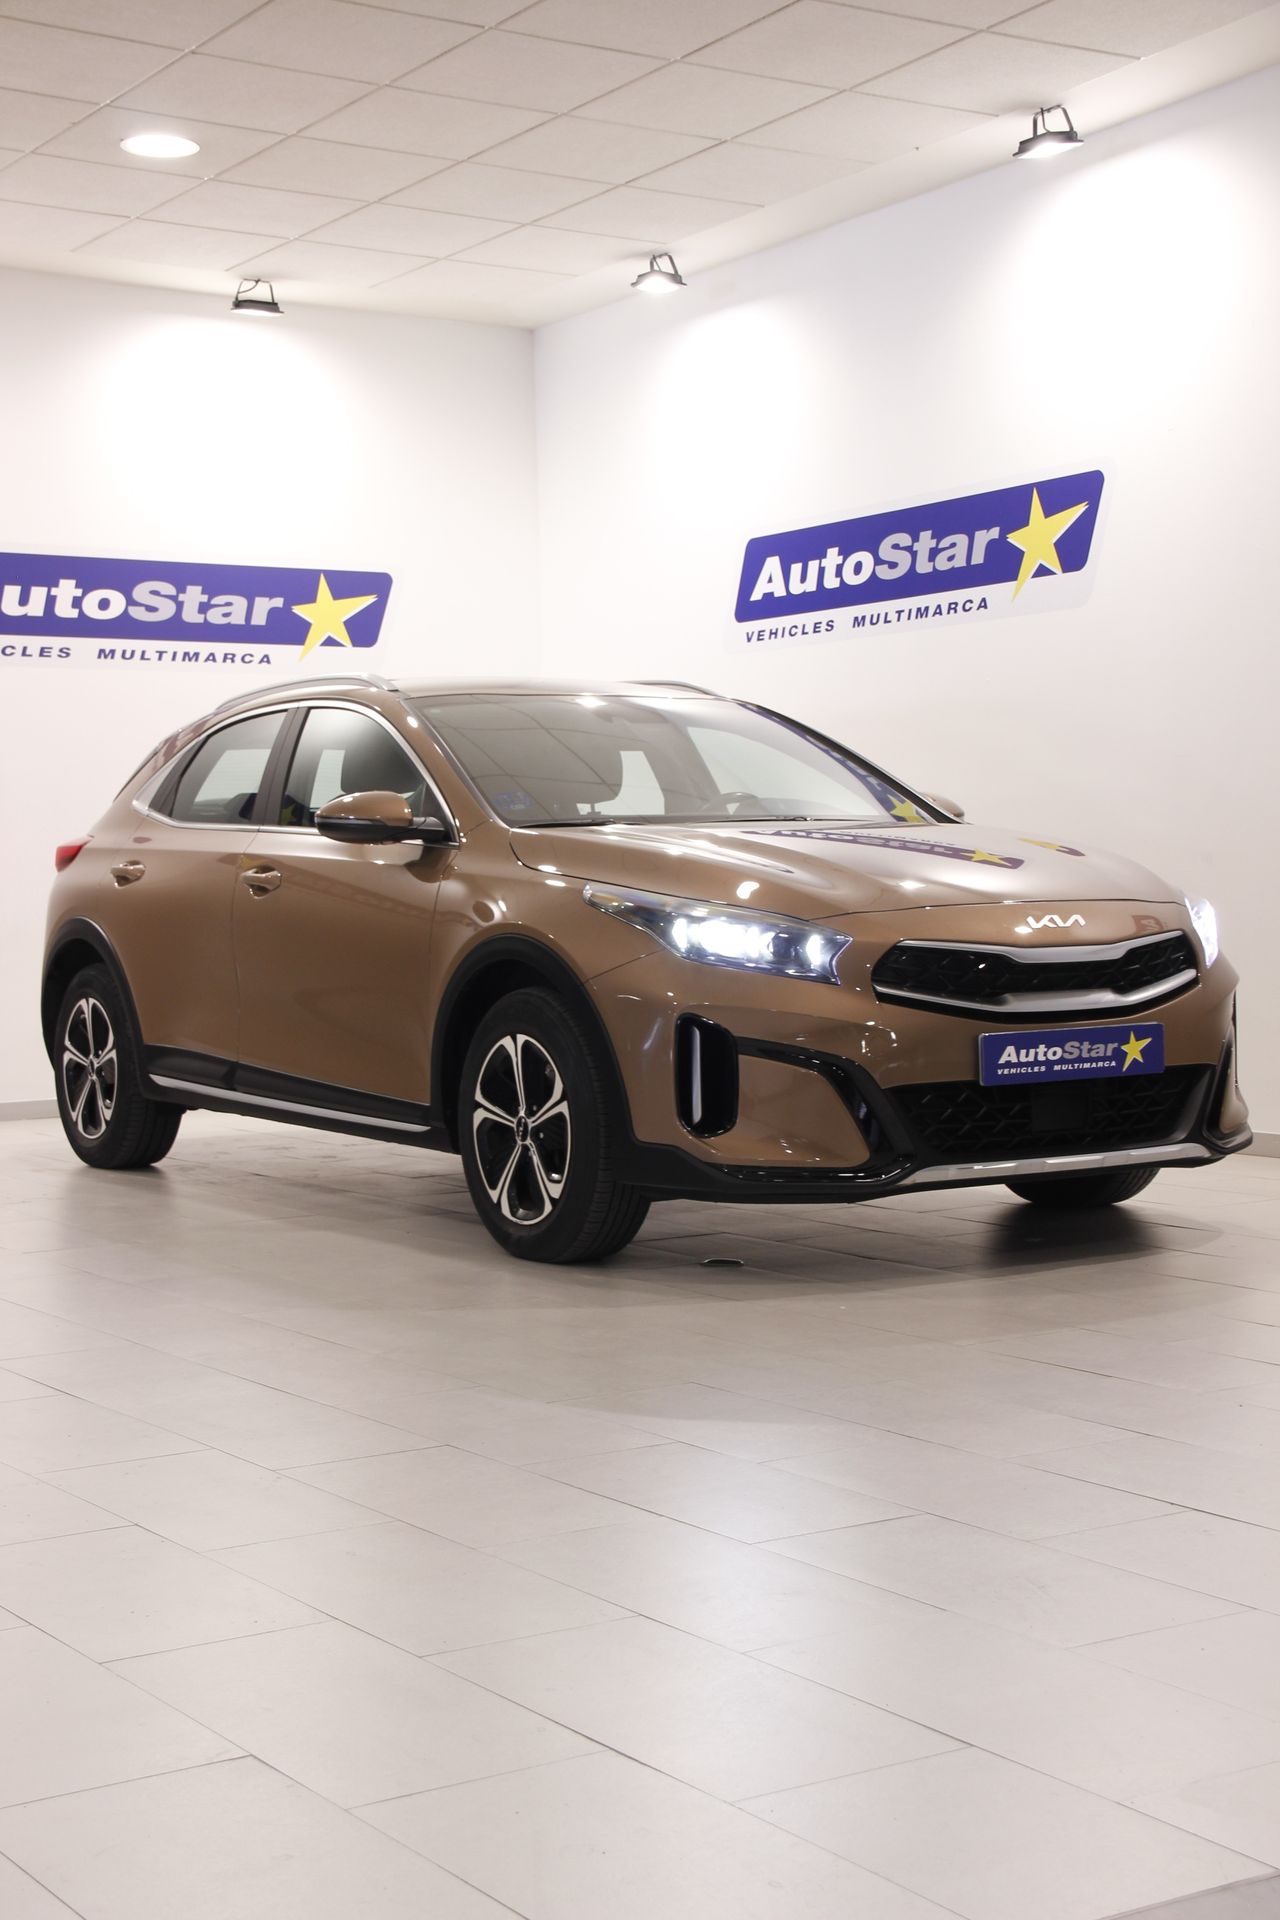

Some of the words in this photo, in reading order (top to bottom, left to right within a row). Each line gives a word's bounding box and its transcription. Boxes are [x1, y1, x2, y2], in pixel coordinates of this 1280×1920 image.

[750, 526, 1000, 601] AutoStar
[745, 619, 835, 643] VEHICLES
[852, 597, 989, 629] MULTIMARCA
[97, 648, 272, 665] MULTIMARCA
[998, 1041, 1118, 1064] AutoStar
[997, 1066, 1046, 1076] VEHICLES
[1053, 1060, 1117, 1072] MULTIMARCA
